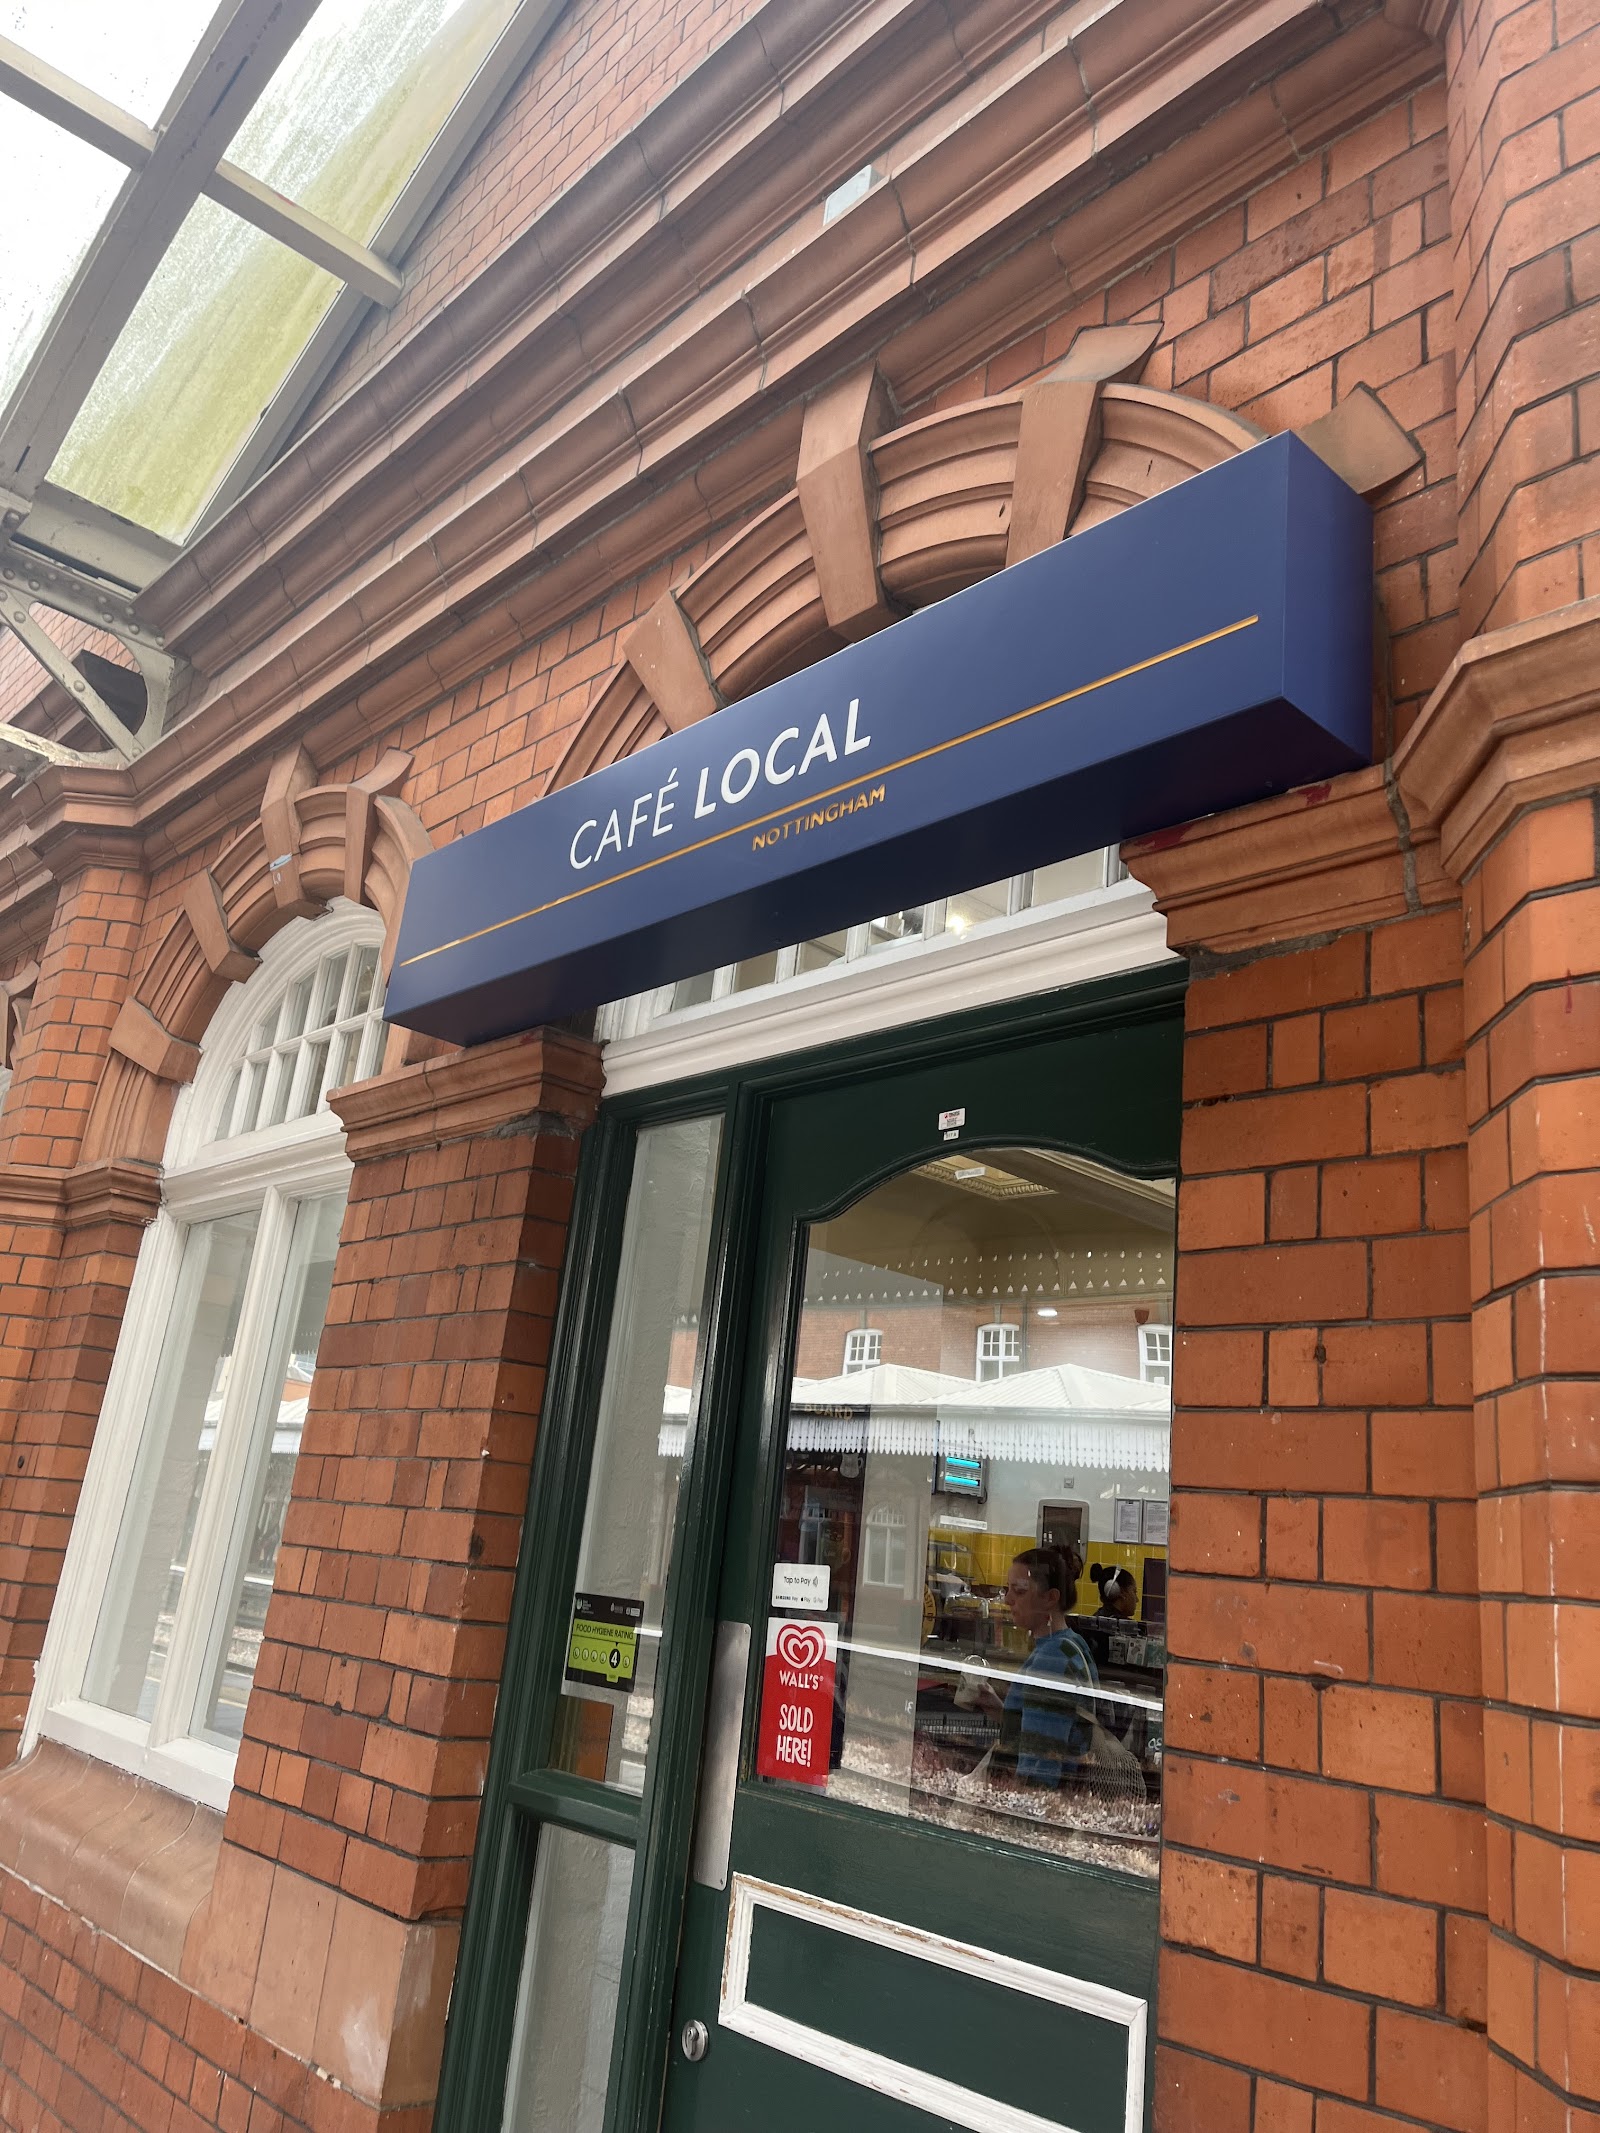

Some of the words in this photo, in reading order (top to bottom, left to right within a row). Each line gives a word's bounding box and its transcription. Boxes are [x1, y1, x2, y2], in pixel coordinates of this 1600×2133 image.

[569, 767, 679, 870] CAFÉ
[694, 698, 871, 820] LOCAL
[752, 784, 886, 851] NOTTINGHAM
[784, 1576, 794, 1586] Tap
[801, 1577, 811, 1587] Pay
[575, 1624, 592, 1633] FOOD
[592, 1627, 614, 1637] HYGIENE
[614, 1630, 634, 1640] RATING
[610, 1651, 618, 1667] 4
[779, 1670, 819, 1690] WALL'S
[779, 1704, 814, 1733] SOLD
[776, 1735, 812, 1768] HERE!
